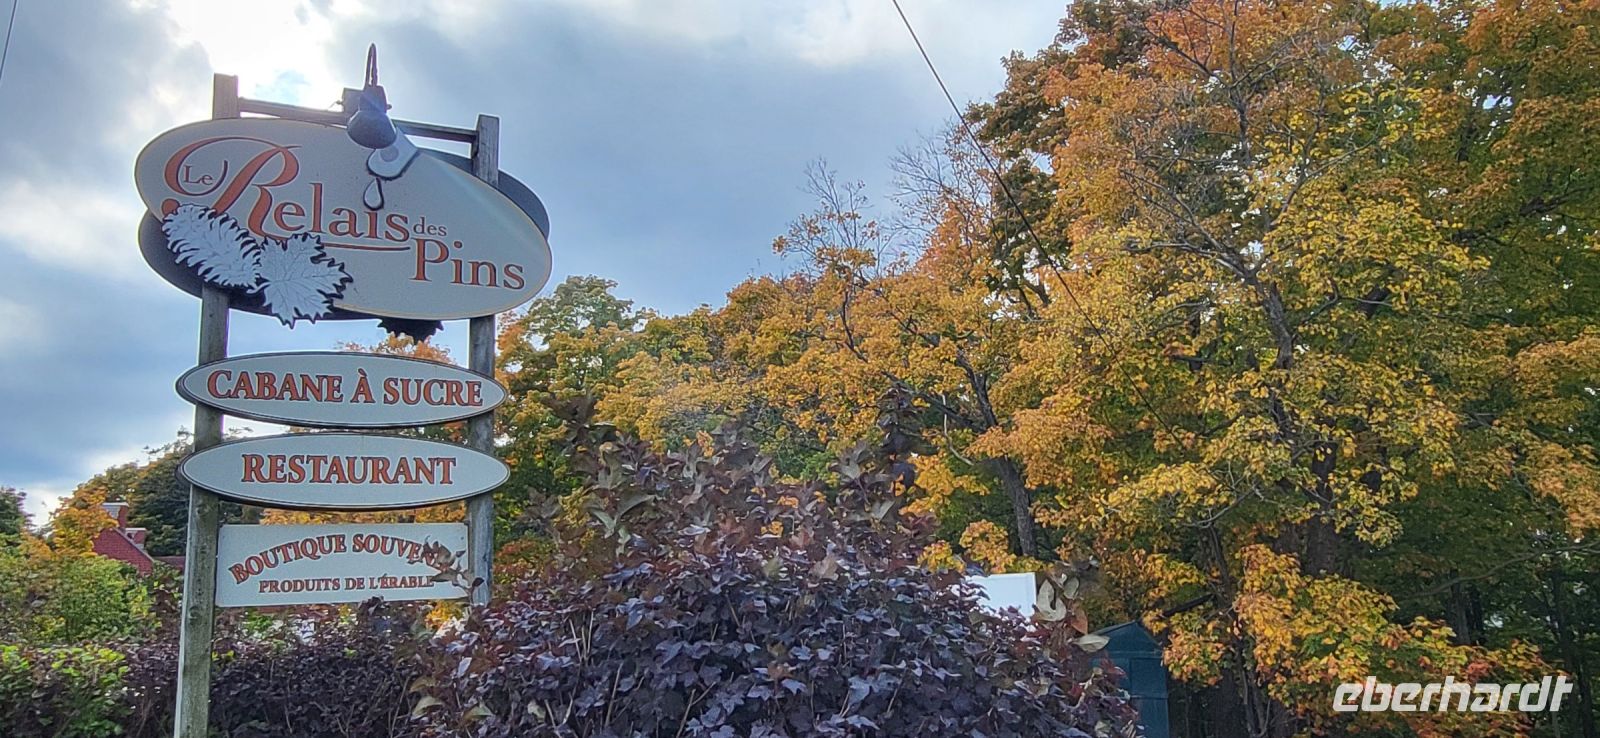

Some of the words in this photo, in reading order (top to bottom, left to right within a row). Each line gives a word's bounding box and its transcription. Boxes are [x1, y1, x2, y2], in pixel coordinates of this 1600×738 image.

[183, 165, 213, 185] Le
[161, 136, 410, 249] Relais
[413, 217, 448, 237] des
[411, 238, 526, 290] Pins
[207, 370, 344, 402] CABANE
[350, 368, 375, 404] À
[383, 377, 483, 407] SUCRE
[241, 454, 456, 484] RESTAURANT
[228, 534, 346, 584] BOUTIQUE
[258, 577, 341, 594] PRODUITS
[344, 576, 365, 590] DE
